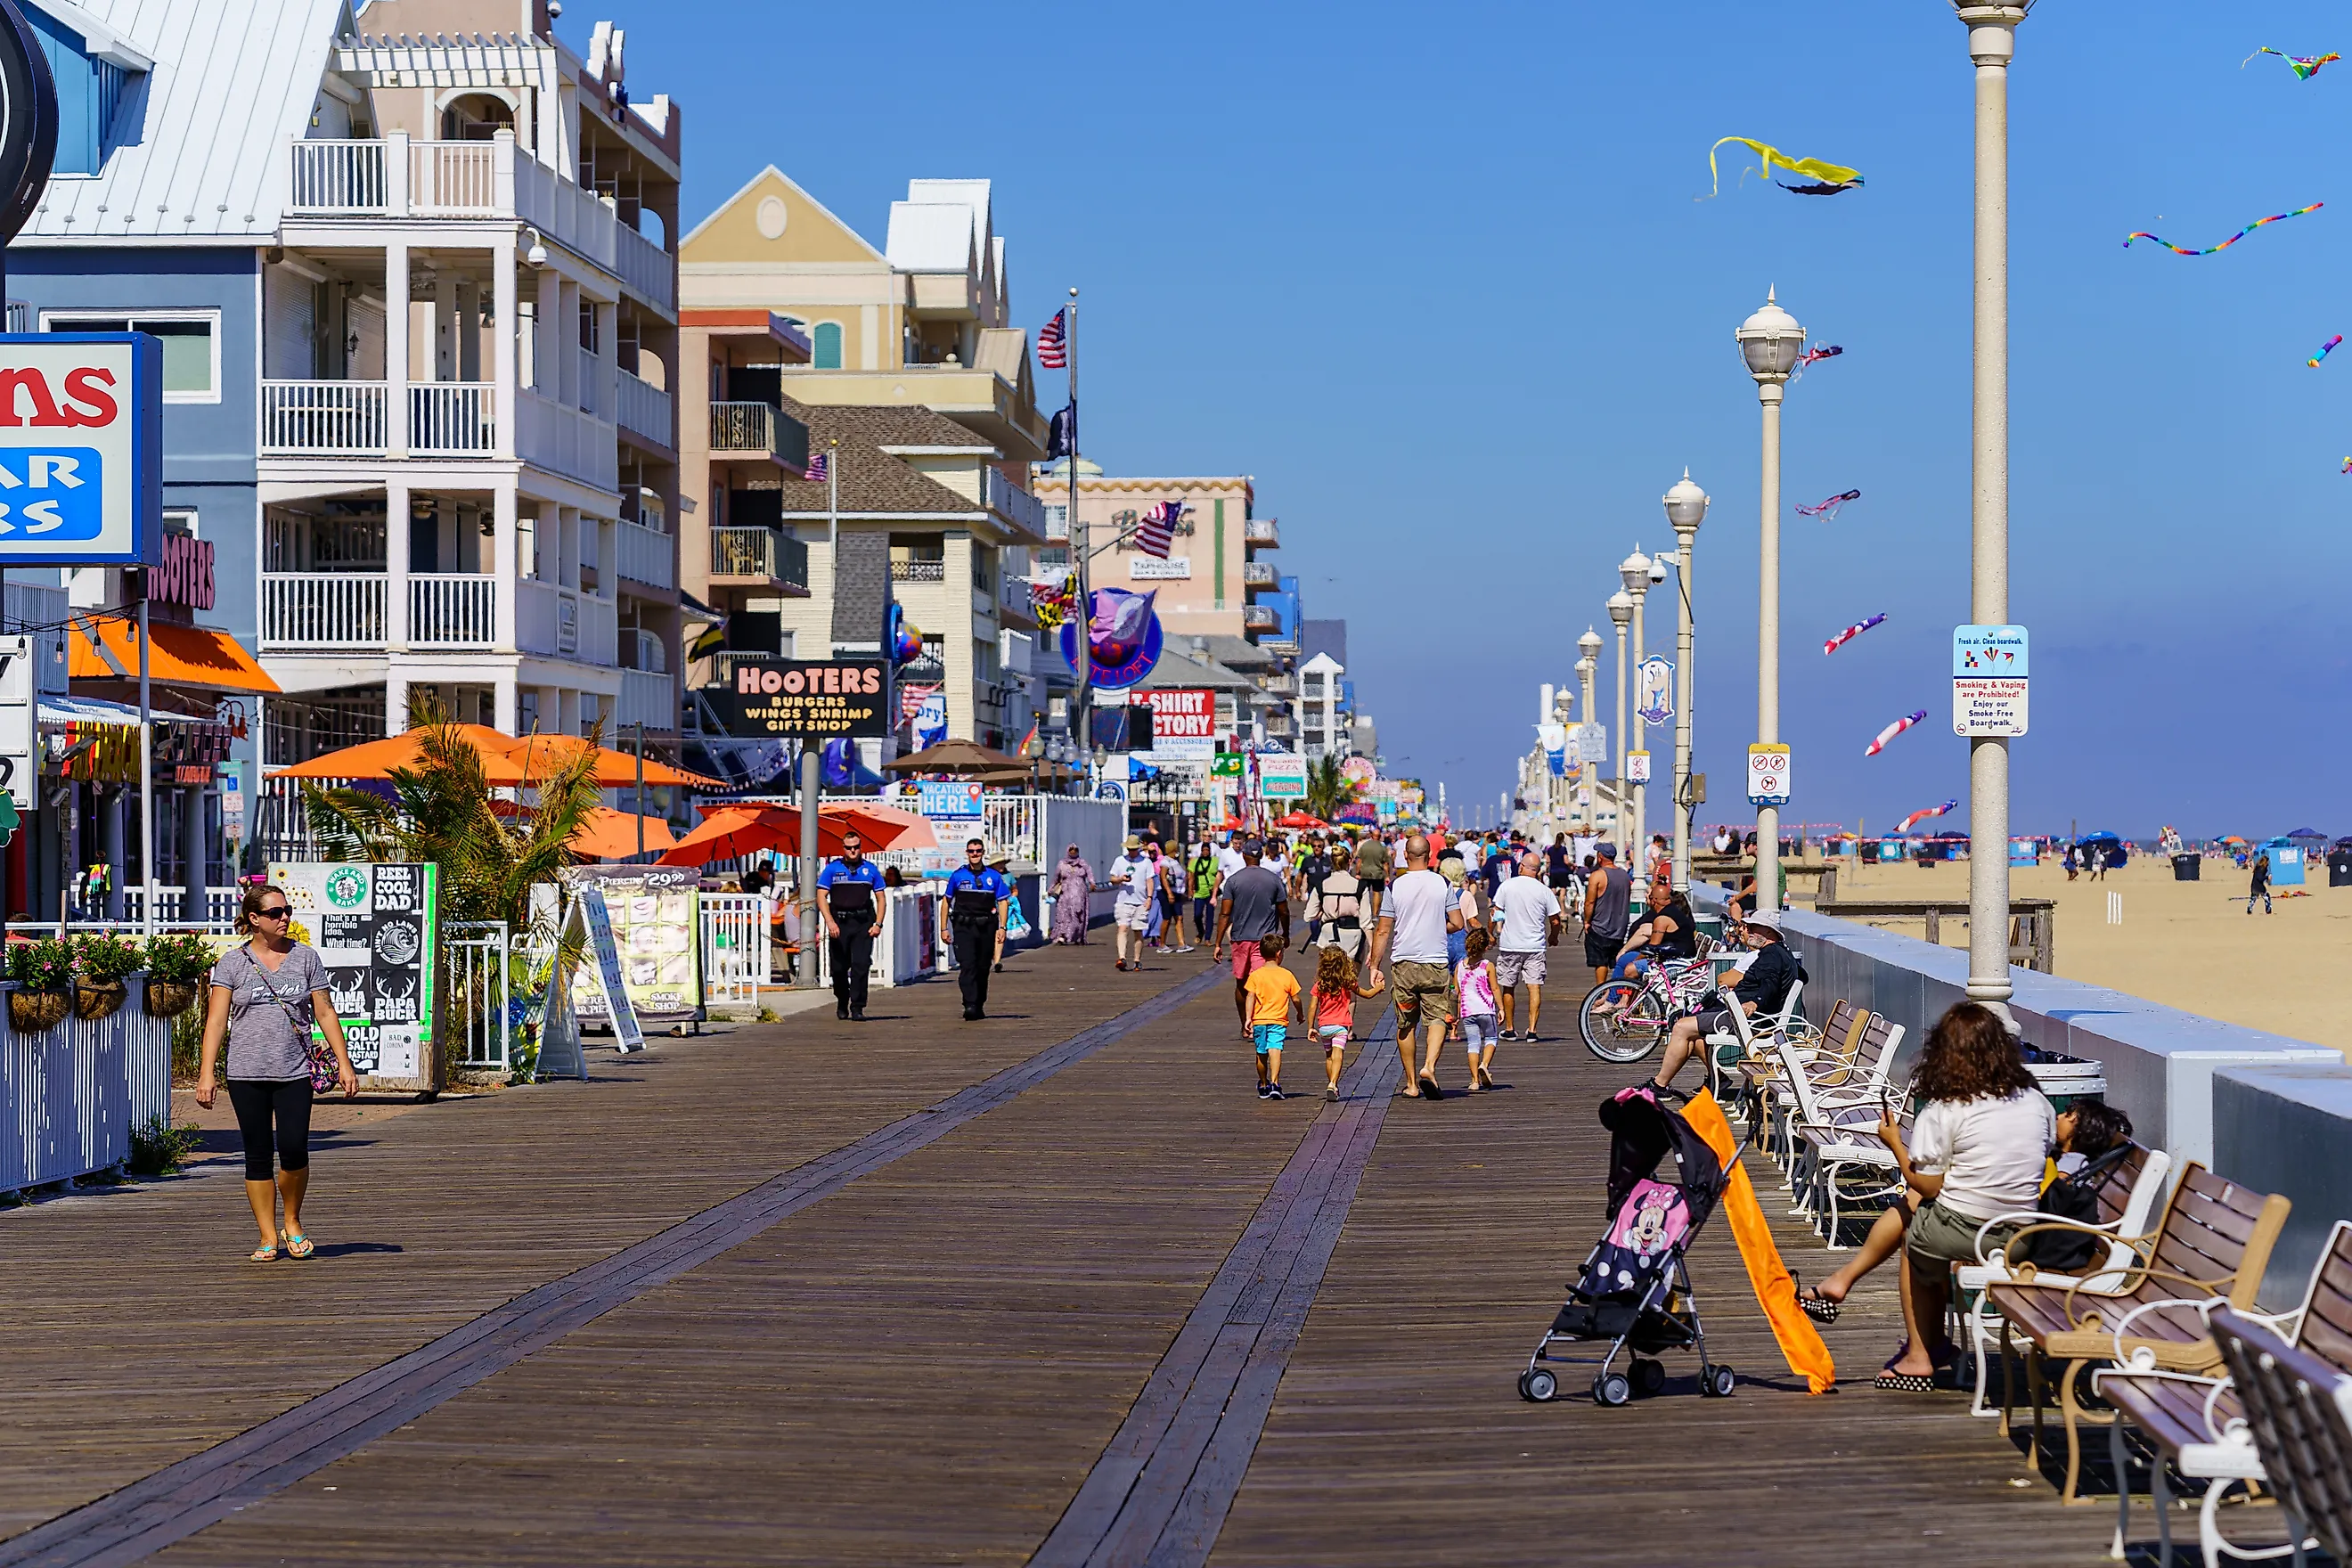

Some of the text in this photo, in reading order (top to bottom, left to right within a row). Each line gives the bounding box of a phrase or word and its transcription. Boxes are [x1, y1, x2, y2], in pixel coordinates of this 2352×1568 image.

[1115, 651, 1153, 682] LOFT
[738, 667, 880, 694] HOOTERS
[1956, 681, 1988, 690] Smoking
[2000, 681, 2026, 690] Vaping
[772, 696, 846, 707] BURGERS
[1972, 700, 1994, 709] Enjoy
[745, 707, 873, 719] WINGS SHRIMP
[1968, 709, 2014, 717] Smoke-Free
[766, 720, 853, 731] GIFT SHOP
[1153, 715, 1211, 736] CTORY
[923, 784, 968, 795] VACATION
[923, 795, 969, 813] HERE
[328, 869, 349, 885] WAKE
[350, 869, 365, 885] AND
[377, 867, 412, 881] REEL
[375, 880, 412, 894] COOL
[336, 898, 356, 907] BAKE
[375, 894, 412, 911] DAD
[324, 921, 358, 929] horrible
[381, 921, 394, 932] NO
[396, 919, 418, 935] LAWS
[326, 938, 368, 948] What time?
[251, 984, 301, 1000] Eales
[650, 992, 683, 1002] SMOKE
[334, 1002, 366, 1015] UCK
[374, 998, 417, 1009] PAPA
[654, 1001, 681, 1010] SHOP
[374, 1009, 417, 1021] BUCK
[347, 1026, 380, 1041] OLD
[347, 1041, 380, 1051] SALTY
[347, 1050, 379, 1059] BASTARD
